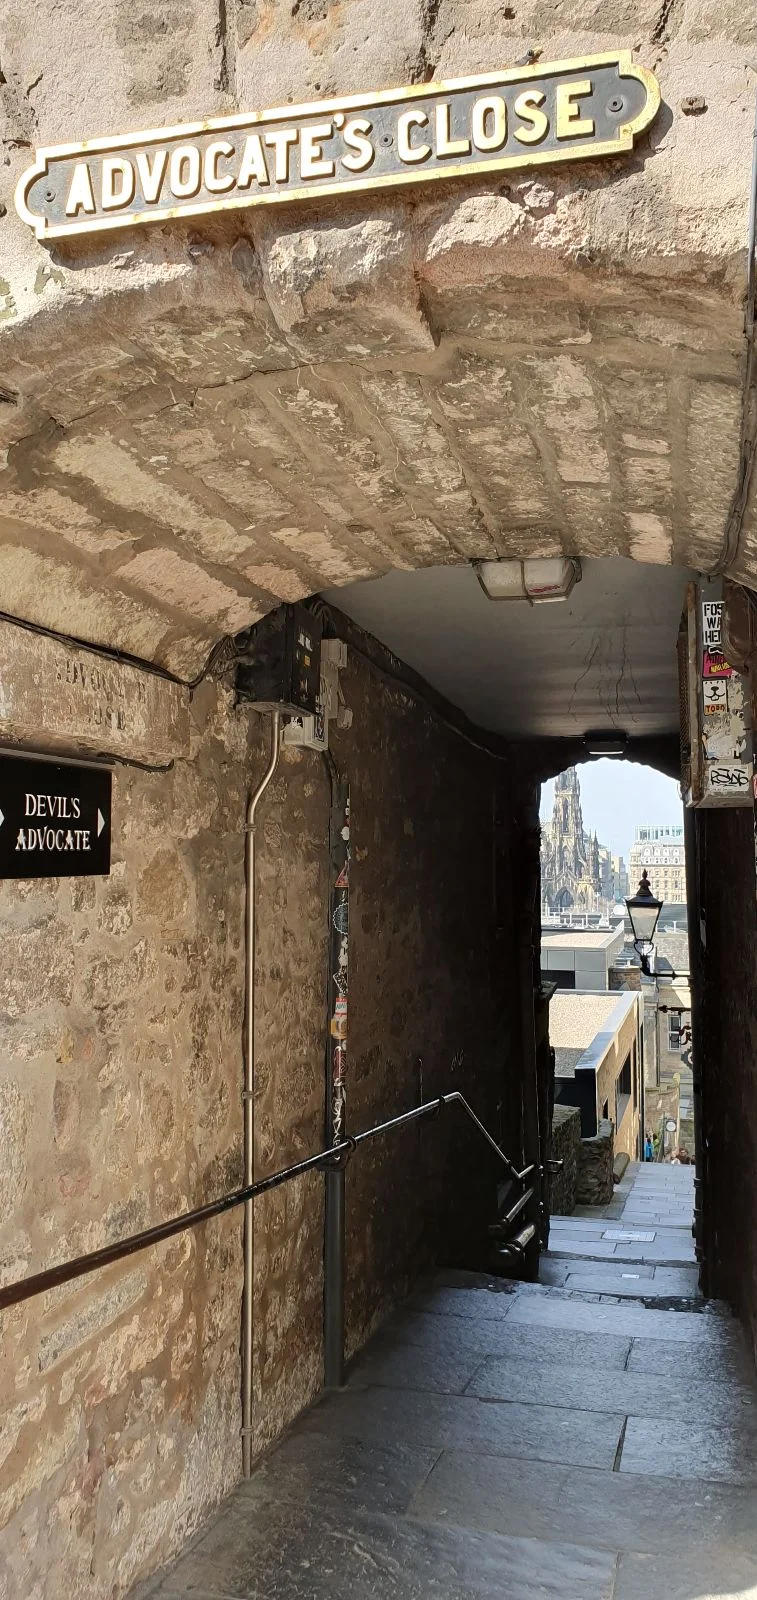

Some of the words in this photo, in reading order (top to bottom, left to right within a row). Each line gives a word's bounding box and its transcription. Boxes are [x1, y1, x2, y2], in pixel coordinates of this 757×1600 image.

[66, 113, 373, 216] ADVOCATE'S
[397, 79, 595, 164] CLOSE
[25, 793, 81, 819] DEVIL'S
[15, 825, 91, 851] ADVOCATE
